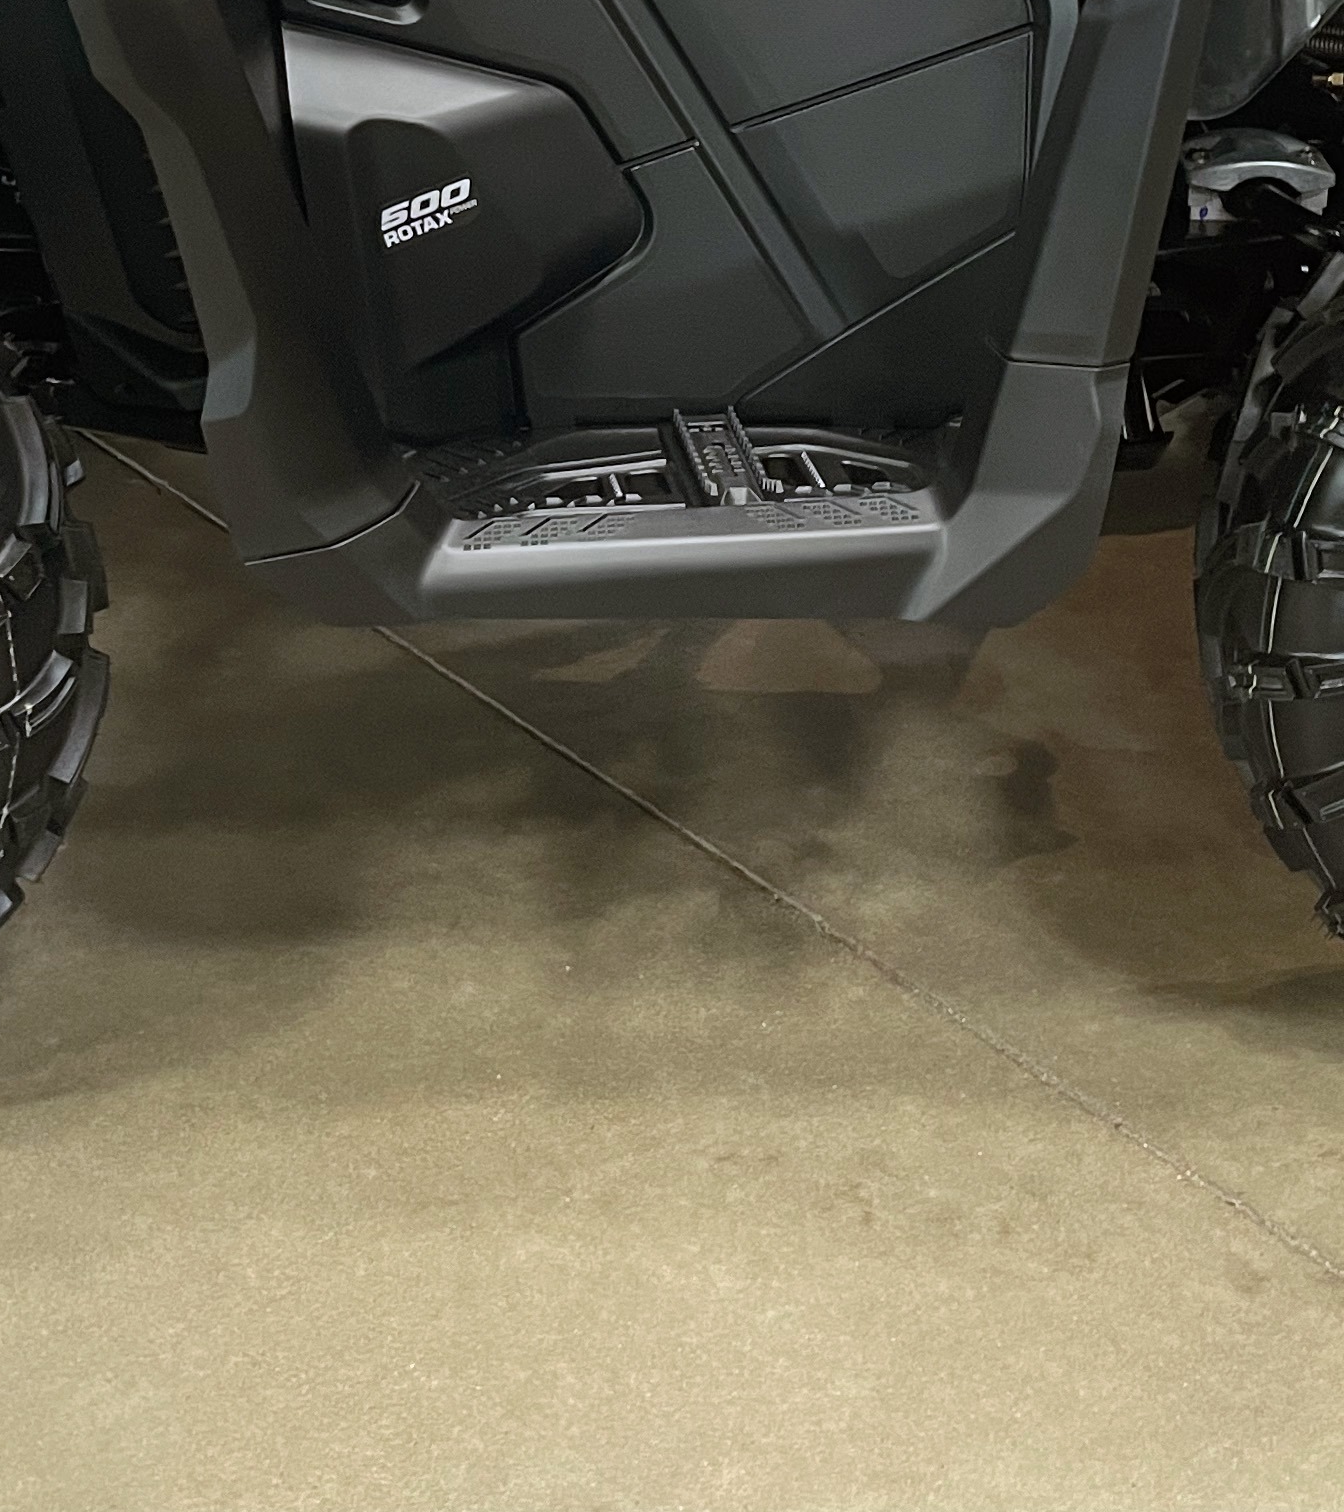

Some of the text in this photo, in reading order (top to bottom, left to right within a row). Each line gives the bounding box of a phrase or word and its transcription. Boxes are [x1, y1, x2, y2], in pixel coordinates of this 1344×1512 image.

[381, 178, 471, 232] 500
[383, 199, 478, 248] ROTAX POWER
